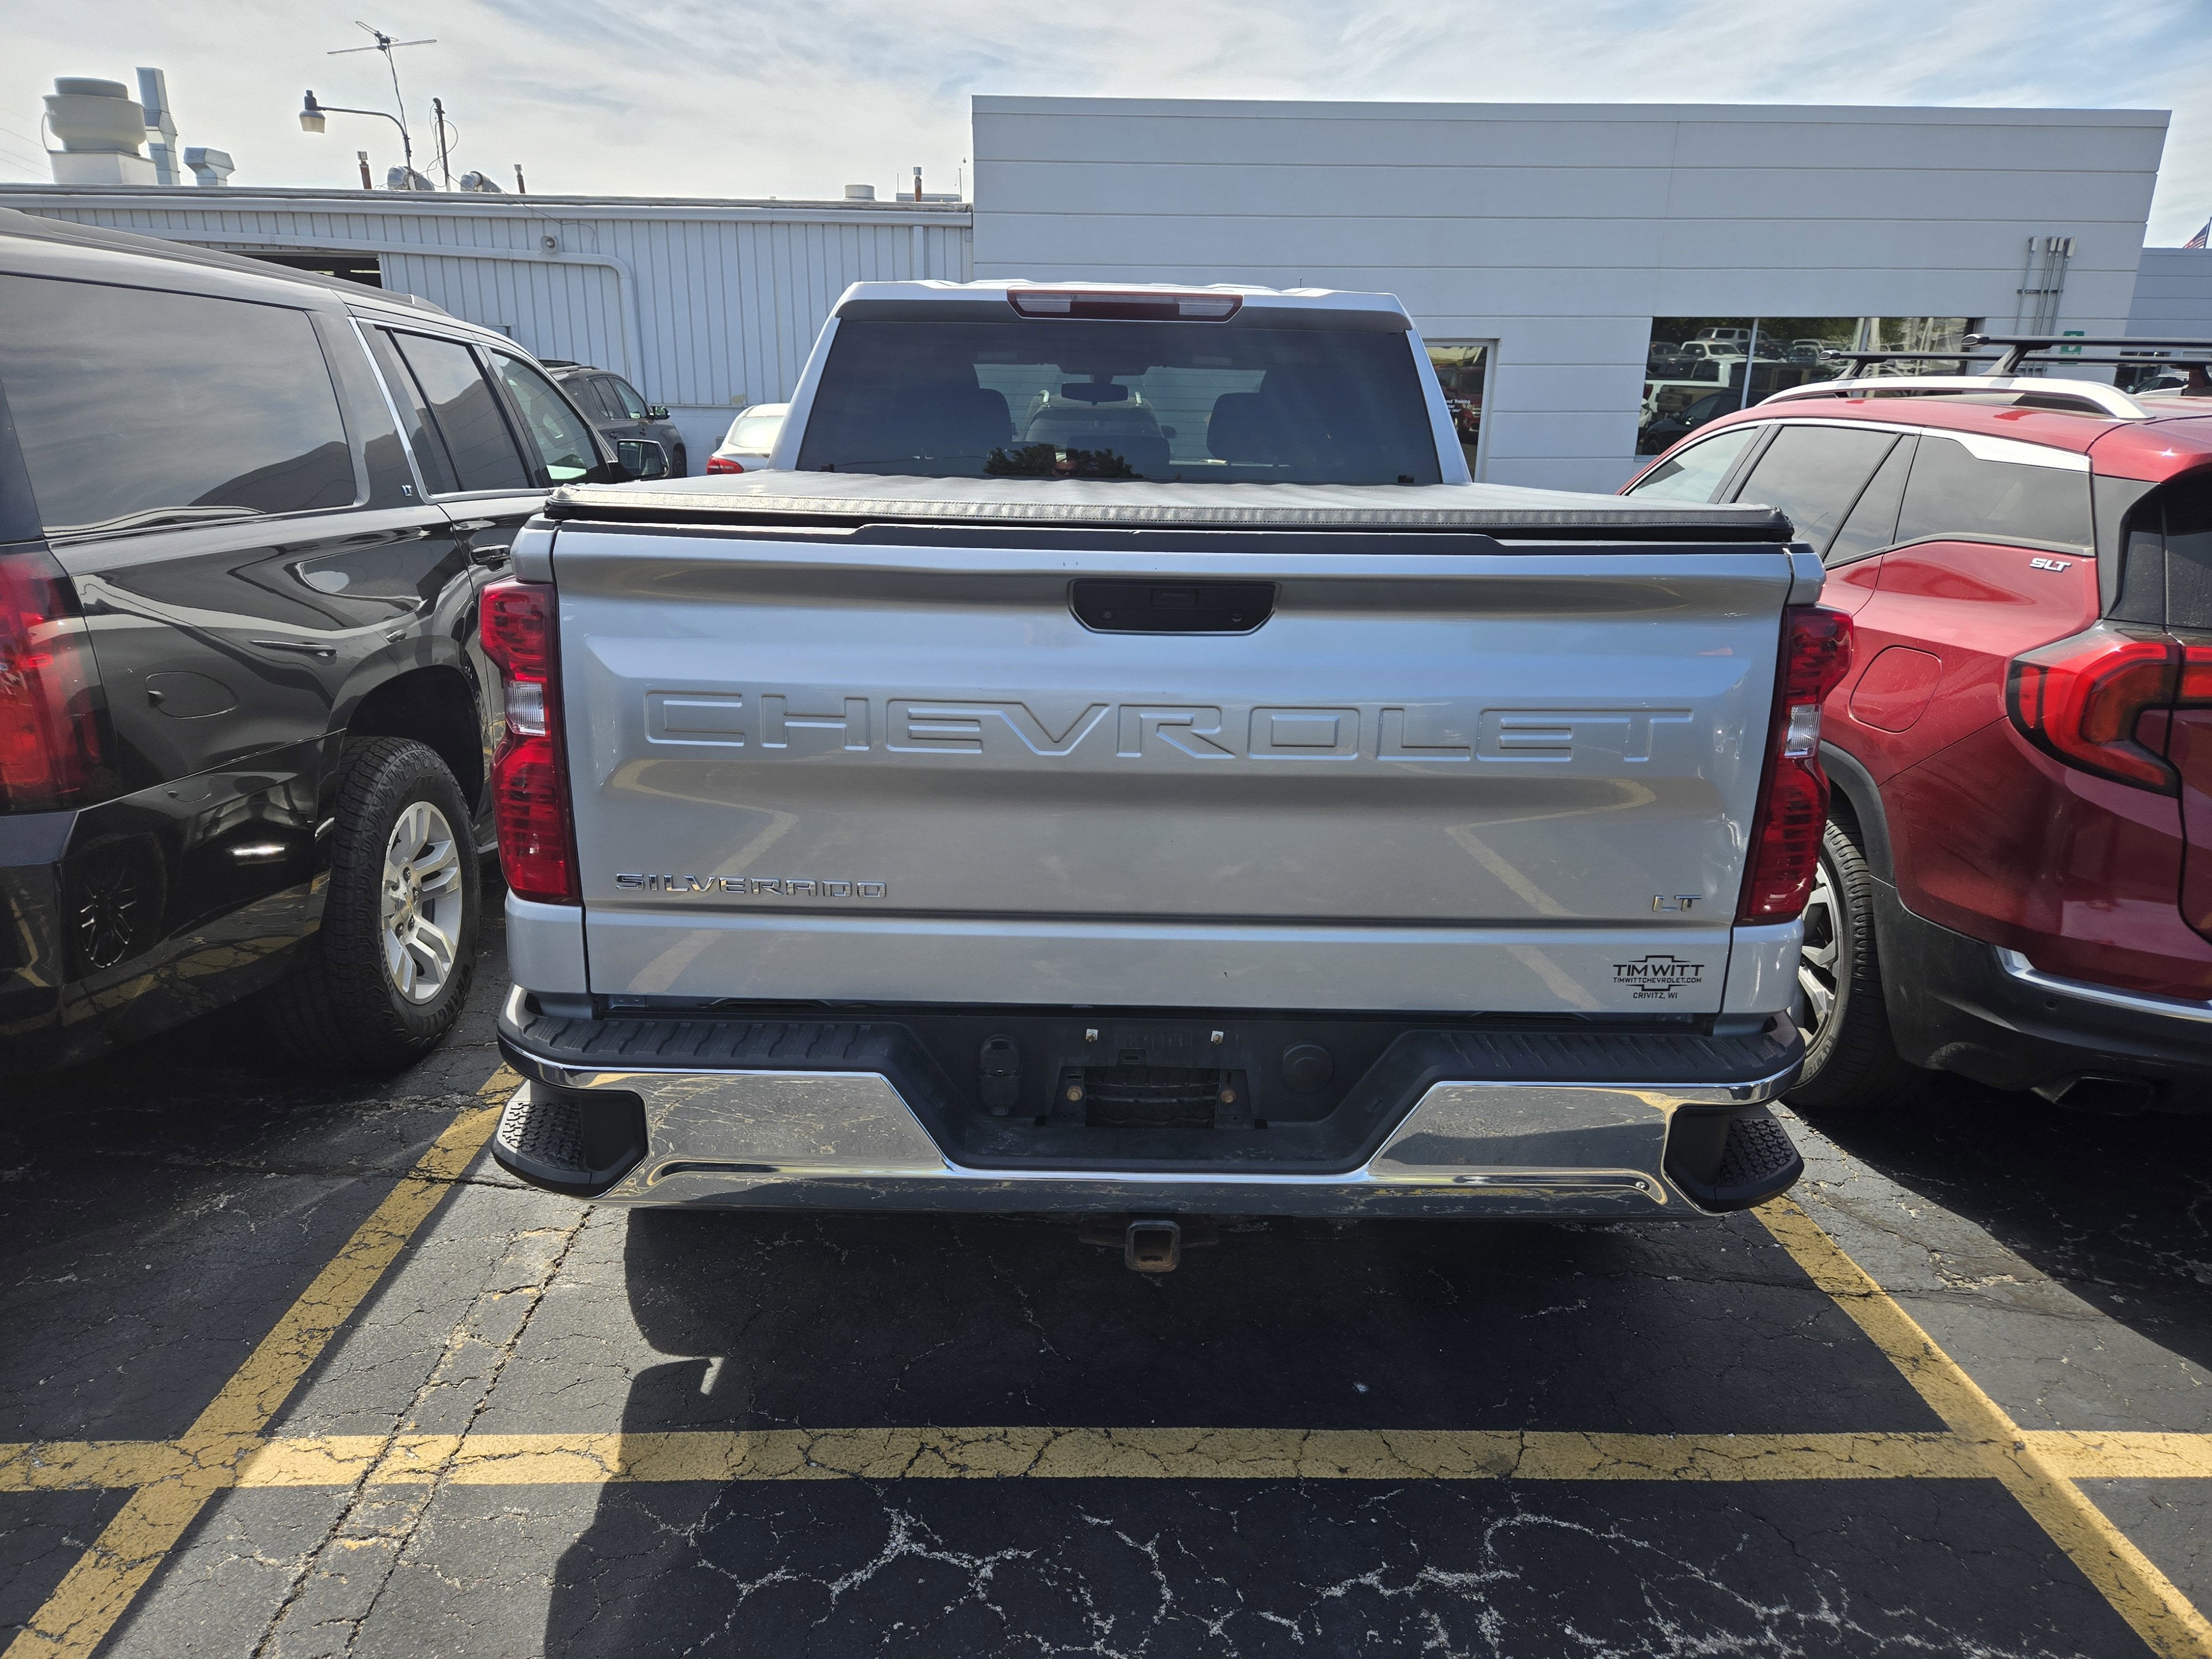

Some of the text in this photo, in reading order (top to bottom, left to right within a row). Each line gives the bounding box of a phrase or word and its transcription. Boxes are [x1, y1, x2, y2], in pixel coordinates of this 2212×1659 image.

[2030, 557, 2072, 572] SLT
[644, 690, 1694, 761] CHEVROLET
[615, 872, 887, 899] SILVERADO
[1652, 895, 1702, 912] LT
[1613, 964, 1704, 976] TIM WITT
